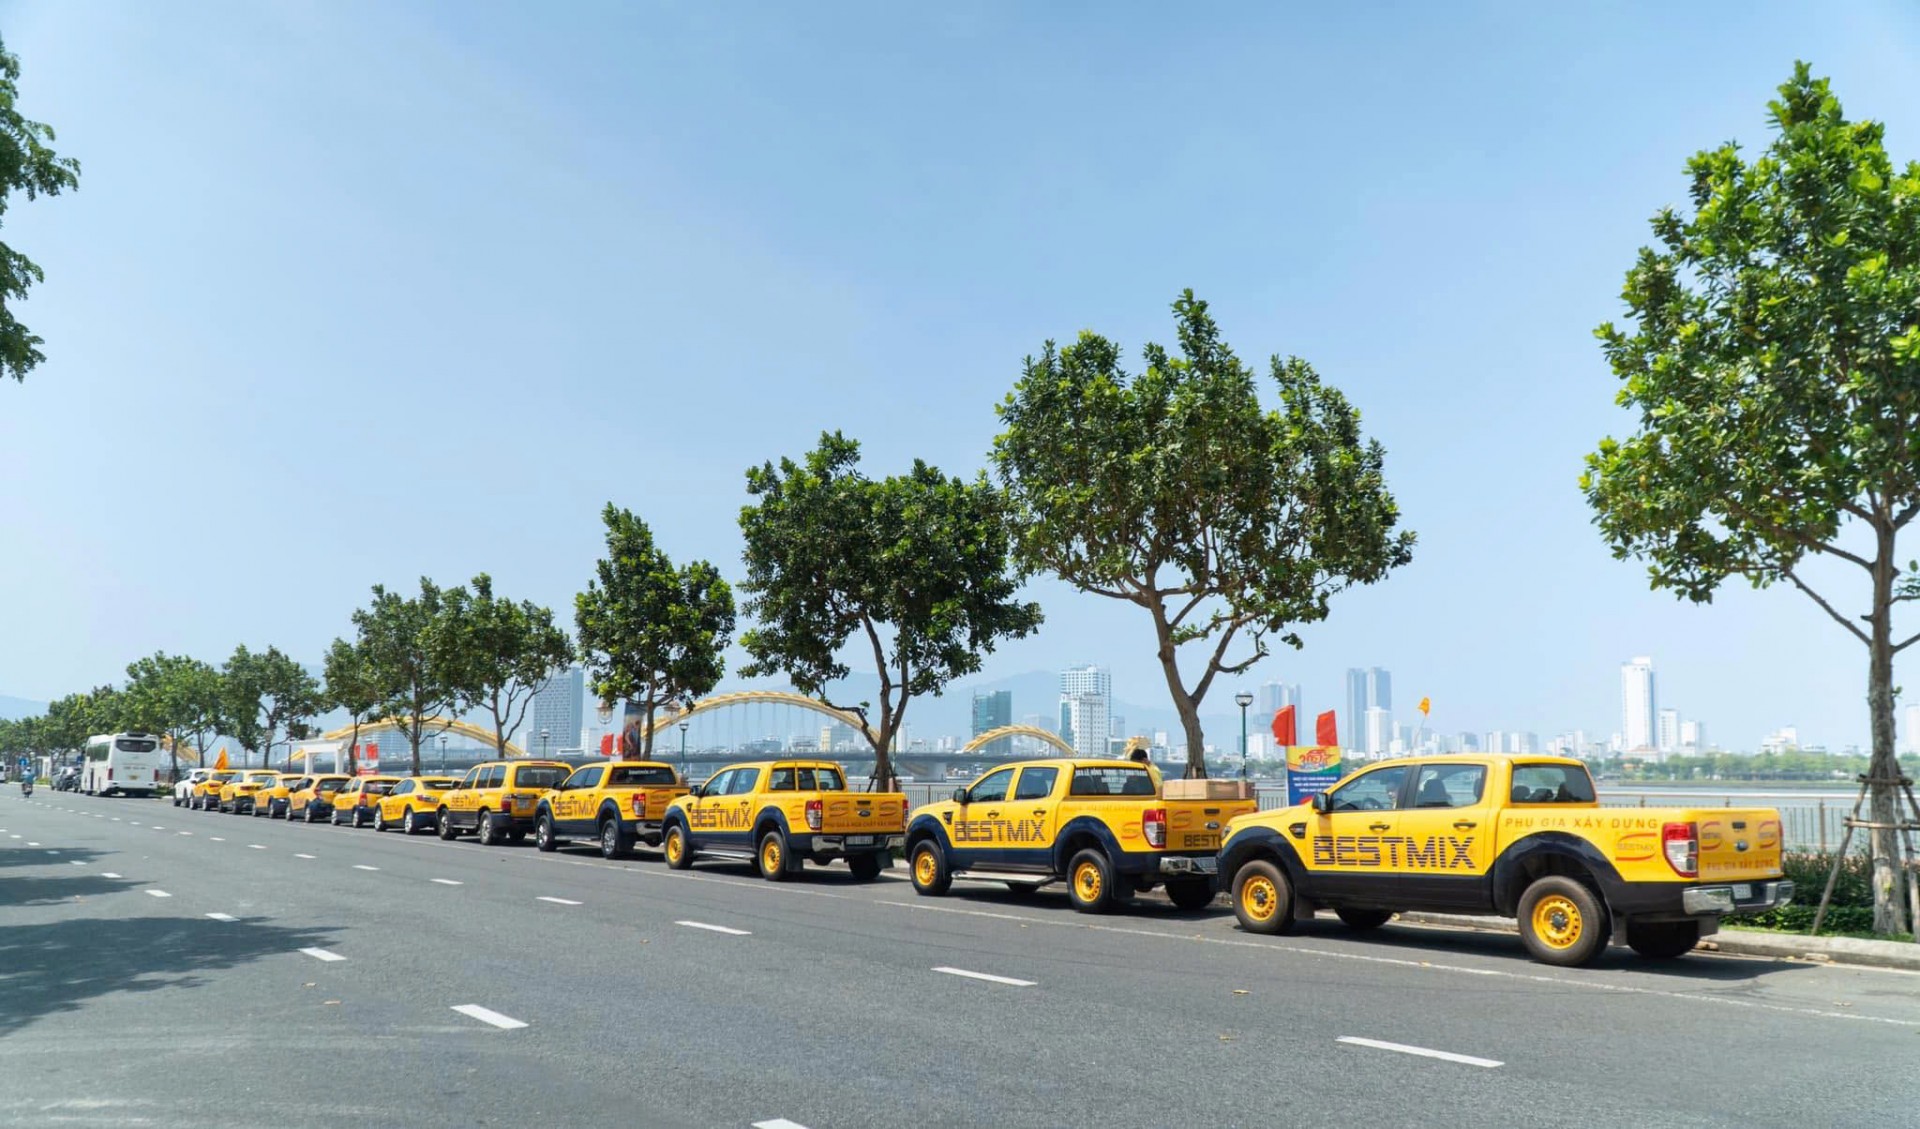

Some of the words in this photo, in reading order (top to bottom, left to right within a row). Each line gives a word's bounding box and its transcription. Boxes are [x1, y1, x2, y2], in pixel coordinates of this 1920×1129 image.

[554, 799, 596, 817] BESTMIX
[691, 808, 751, 827] BESTMIX
[954, 819, 1046, 842] BESTMIX
[1540, 818, 1566, 828] GIA
[1313, 836, 1476, 869] BESTMIX
